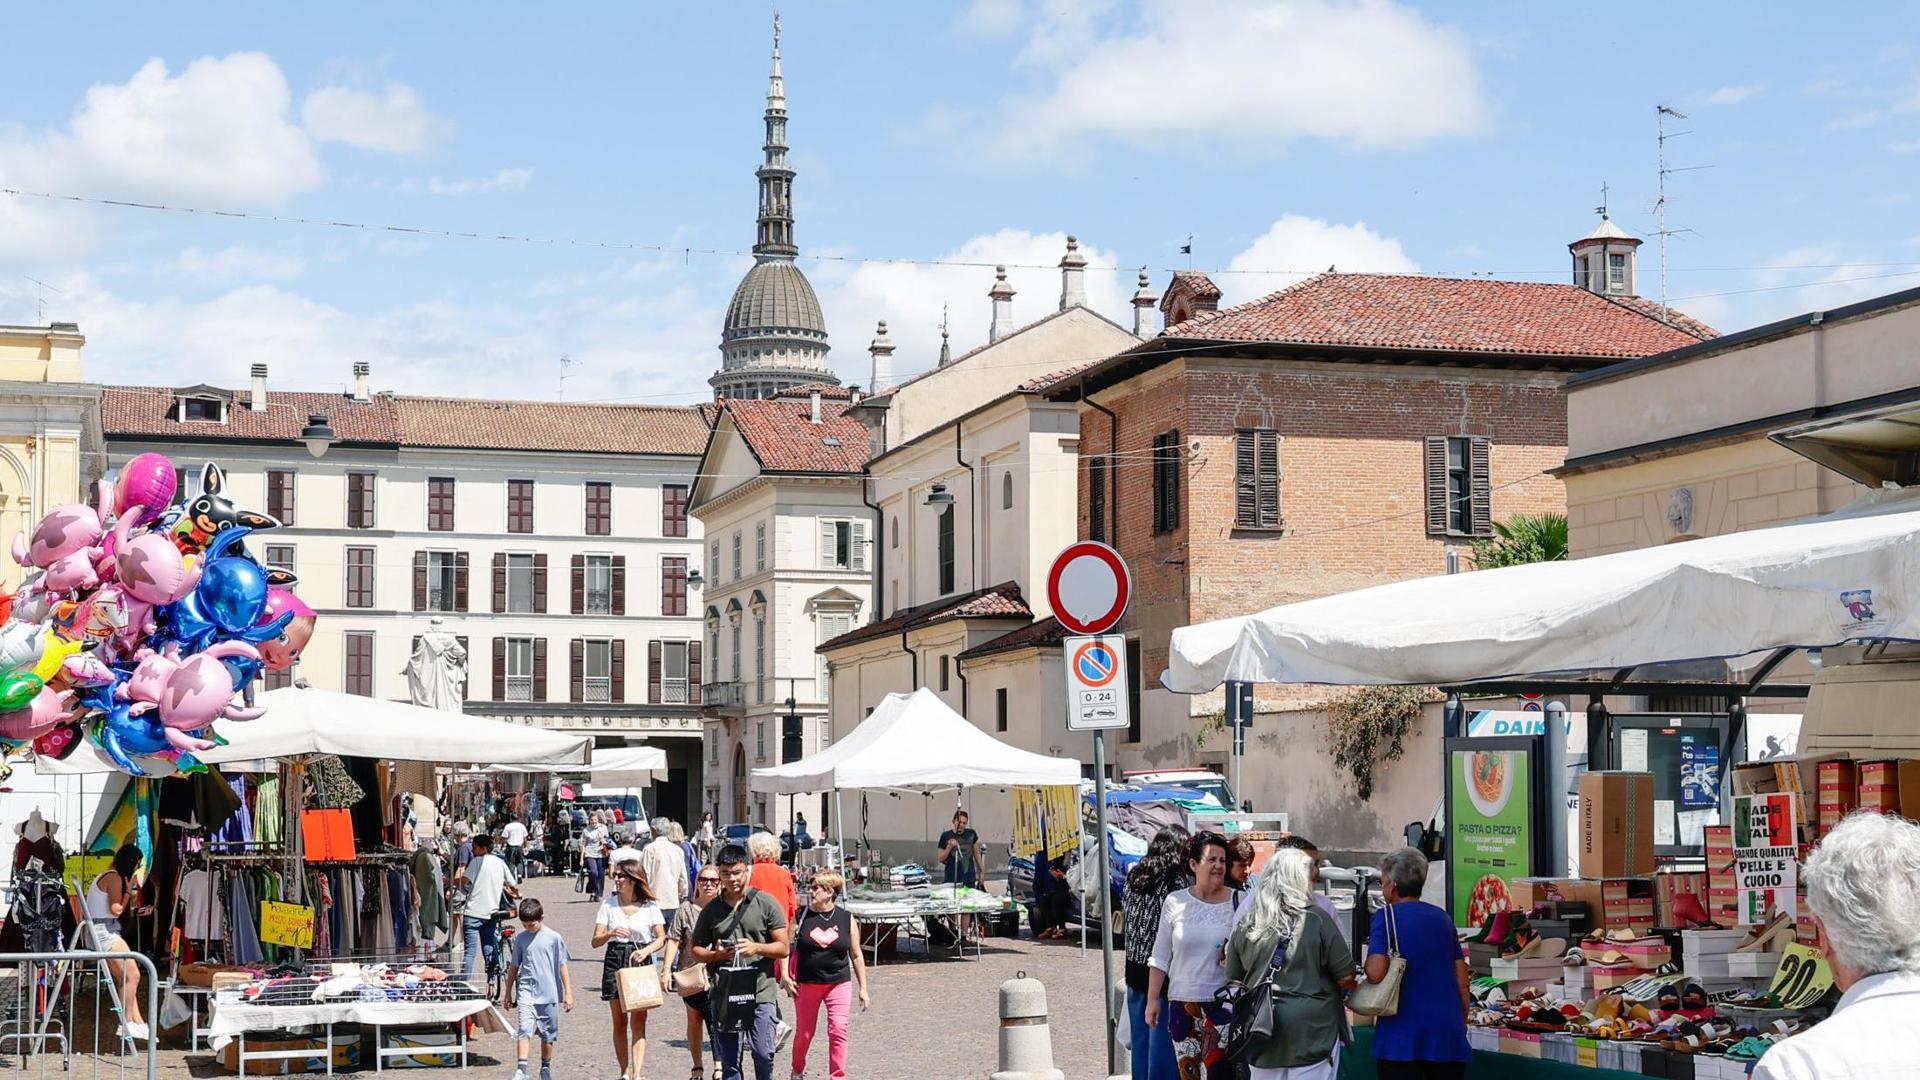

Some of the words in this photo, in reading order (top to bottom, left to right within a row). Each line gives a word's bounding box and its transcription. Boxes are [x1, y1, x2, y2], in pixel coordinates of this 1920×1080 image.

[1085, 693, 1092, 702] 0
[1099, 693, 1111, 701] 24
[1494, 720, 1571, 734] DAIK
[1586, 820, 1592, 831] IN
[1751, 817, 1766, 827] IN
[1458, 824, 1483, 835] PASTA
[1485, 826, 1492, 834] O
[1493, 825, 1522, 836] PIZZA?
[1746, 827, 1780, 838] TALY
[1739, 861, 1773, 873] PELLE
[1777, 860, 1786, 871] E
[1744, 874, 1782, 888] CUOIO
